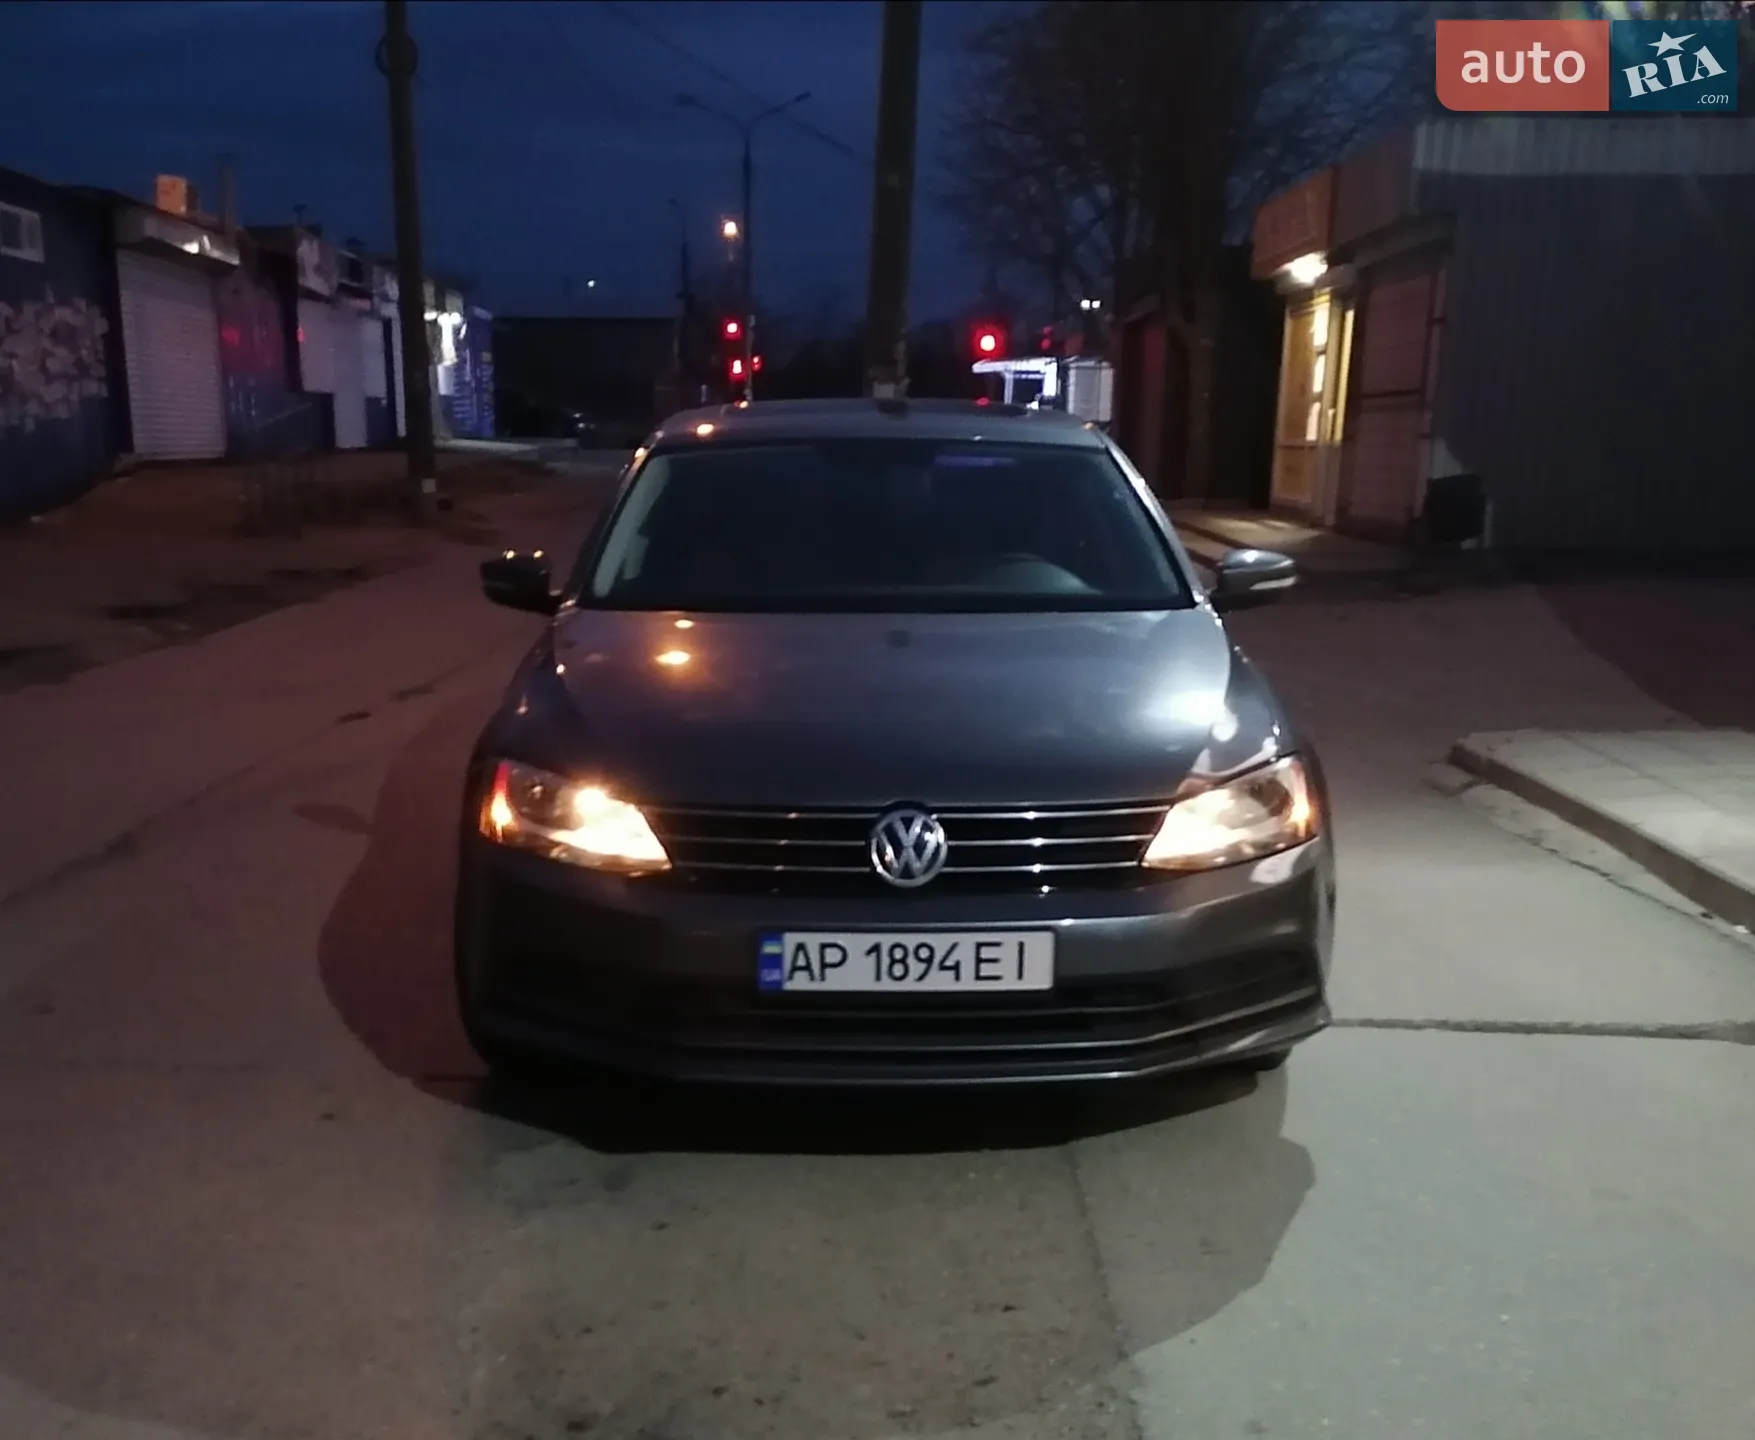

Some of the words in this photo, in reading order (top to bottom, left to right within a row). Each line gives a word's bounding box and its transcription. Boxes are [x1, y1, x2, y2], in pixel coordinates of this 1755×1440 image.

[787, 941, 848, 982] AP
[864, 941, 962, 982] 1894
[973, 941, 1026, 981] EI
